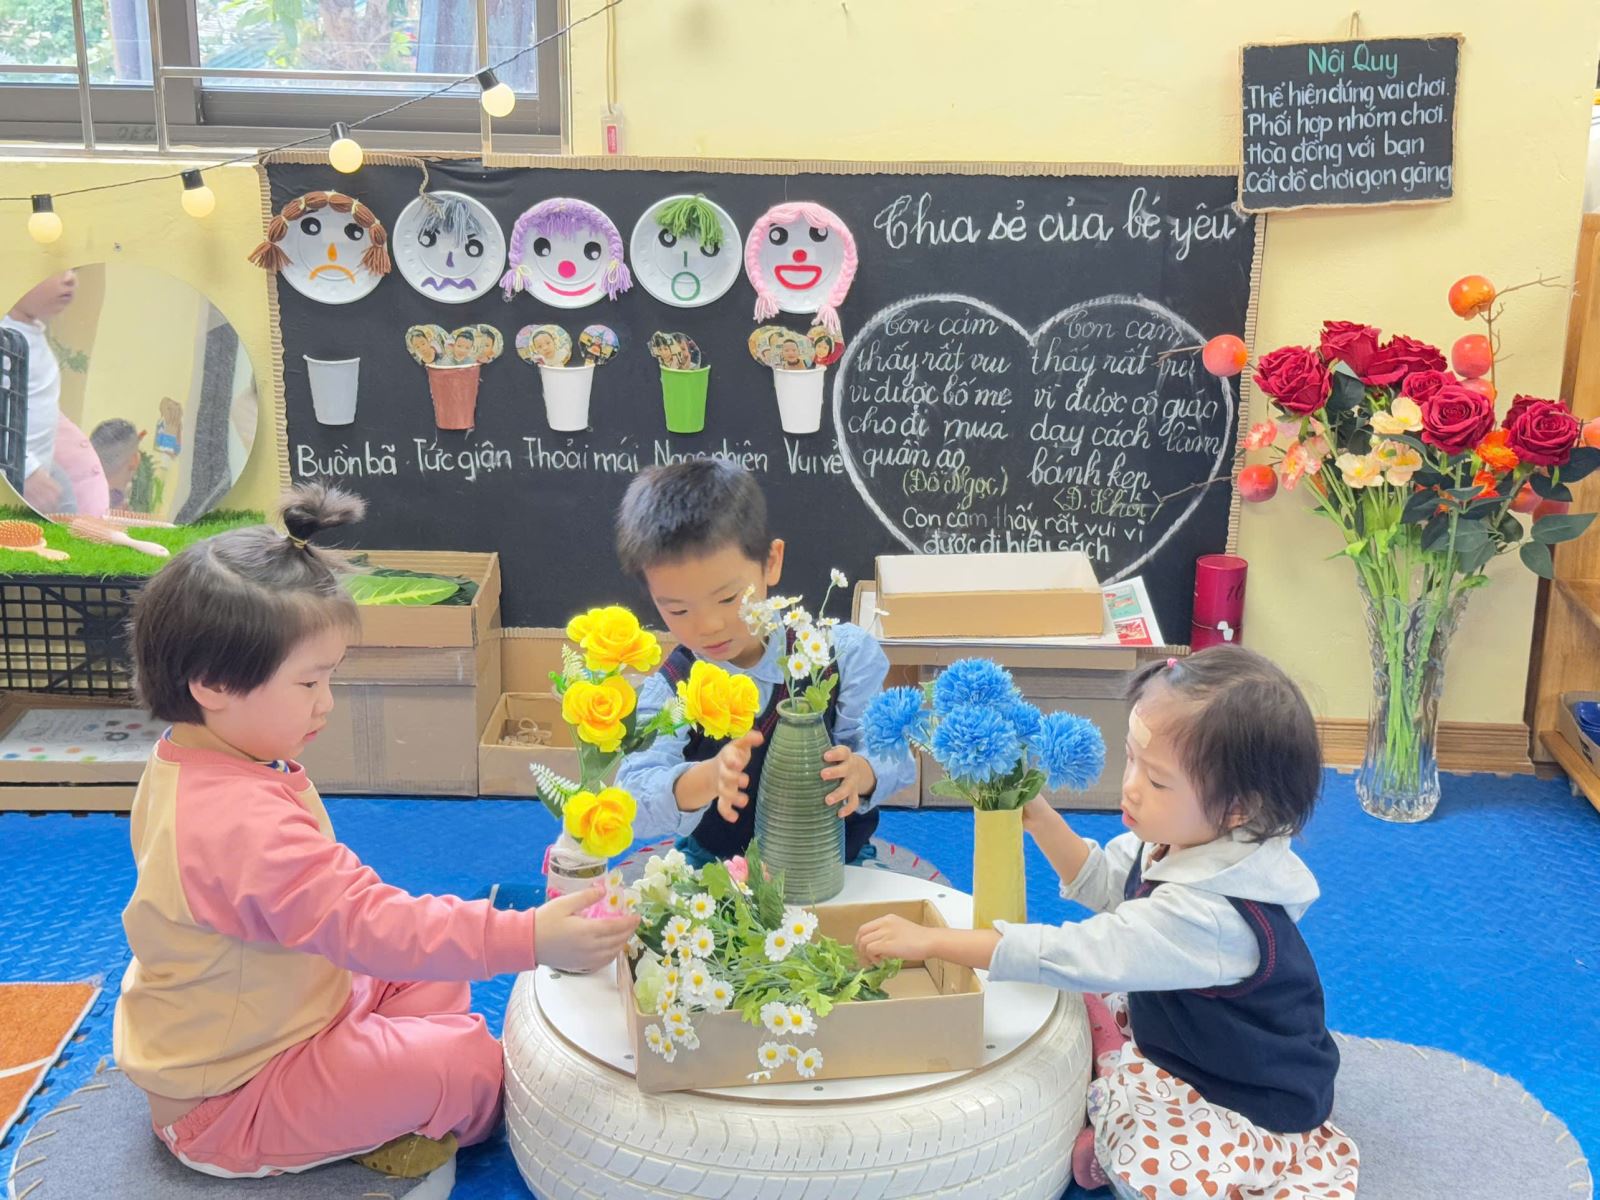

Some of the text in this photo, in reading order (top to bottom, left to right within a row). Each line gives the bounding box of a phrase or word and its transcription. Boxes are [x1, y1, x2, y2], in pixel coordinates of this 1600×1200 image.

[1308, 43, 1398, 79] Nội Quy
[1247, 82, 1285, 110] Thể
[1288, 80, 1327, 109] hiện
[1328, 78, 1374, 108] đúng
[1378, 80, 1404, 101] vai
[1247, 110, 1291, 138] Phối
[1297, 108, 1332, 141] hợp
[1338, 106, 1396, 132] nhóm
[1291, 137, 1343, 167] đồng
[1347, 136, 1375, 158] với
[1384, 131, 1424, 157] bạn
[1246, 167, 1278, 193] Cất
[1278, 166, 1308, 192] đồ
[1310, 165, 1354, 190] chơi
[1356, 168, 1396, 194] gọn
[1039, 197, 1113, 242] của
[1124, 187, 1162, 241] bé
[1170, 203, 1237, 260] yêu
[297, 441, 398, 478] Buồn bã
[413, 438, 512, 483] Tức giận
[522, 436, 639, 473] Thoải mái
[784, 437, 817, 475] Vui
[903, 506, 942, 529] Con
[1084, 520, 1116, 538] vui
